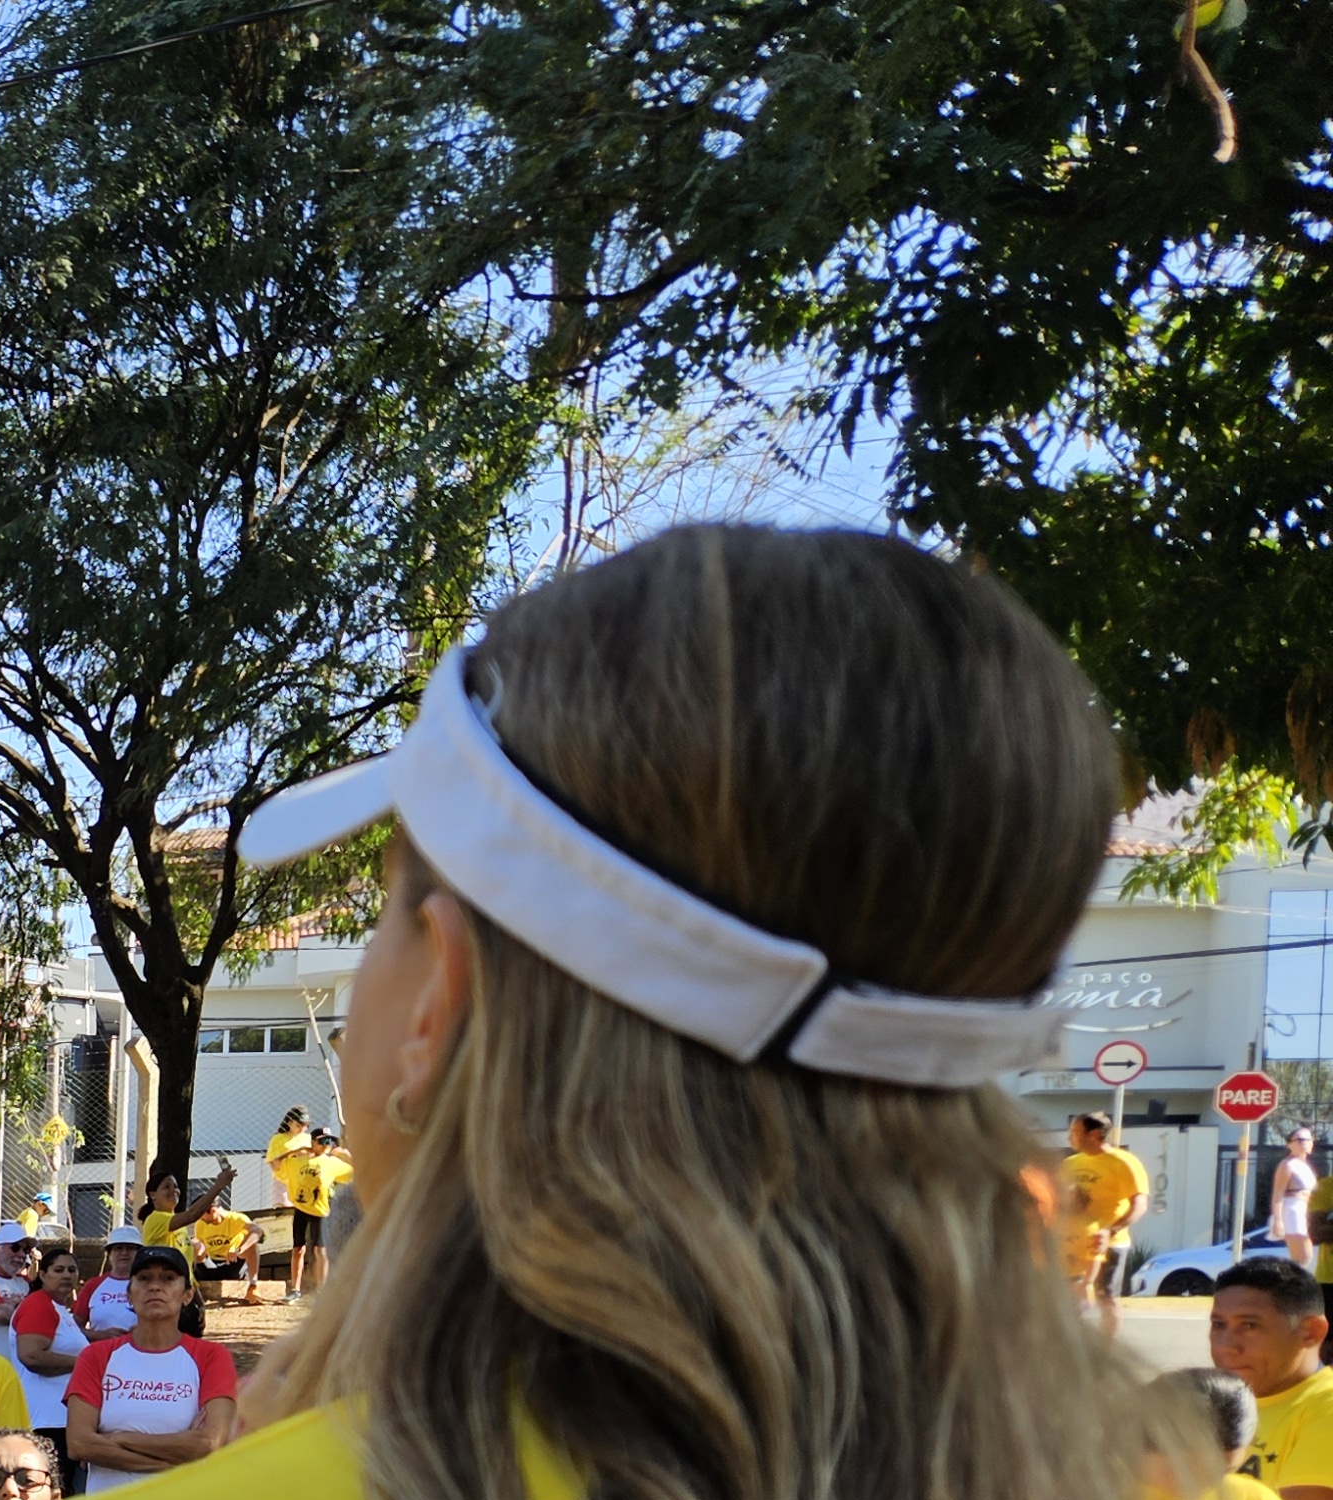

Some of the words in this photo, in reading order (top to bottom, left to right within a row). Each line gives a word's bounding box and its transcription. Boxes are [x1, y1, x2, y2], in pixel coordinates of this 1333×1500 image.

[1067, 972, 1152, 987] paço
[1221, 1089, 1272, 1105] PARE
[102, 1374, 174, 1401] PERNAS
[128, 1391, 178, 1402] ALUGUEL
